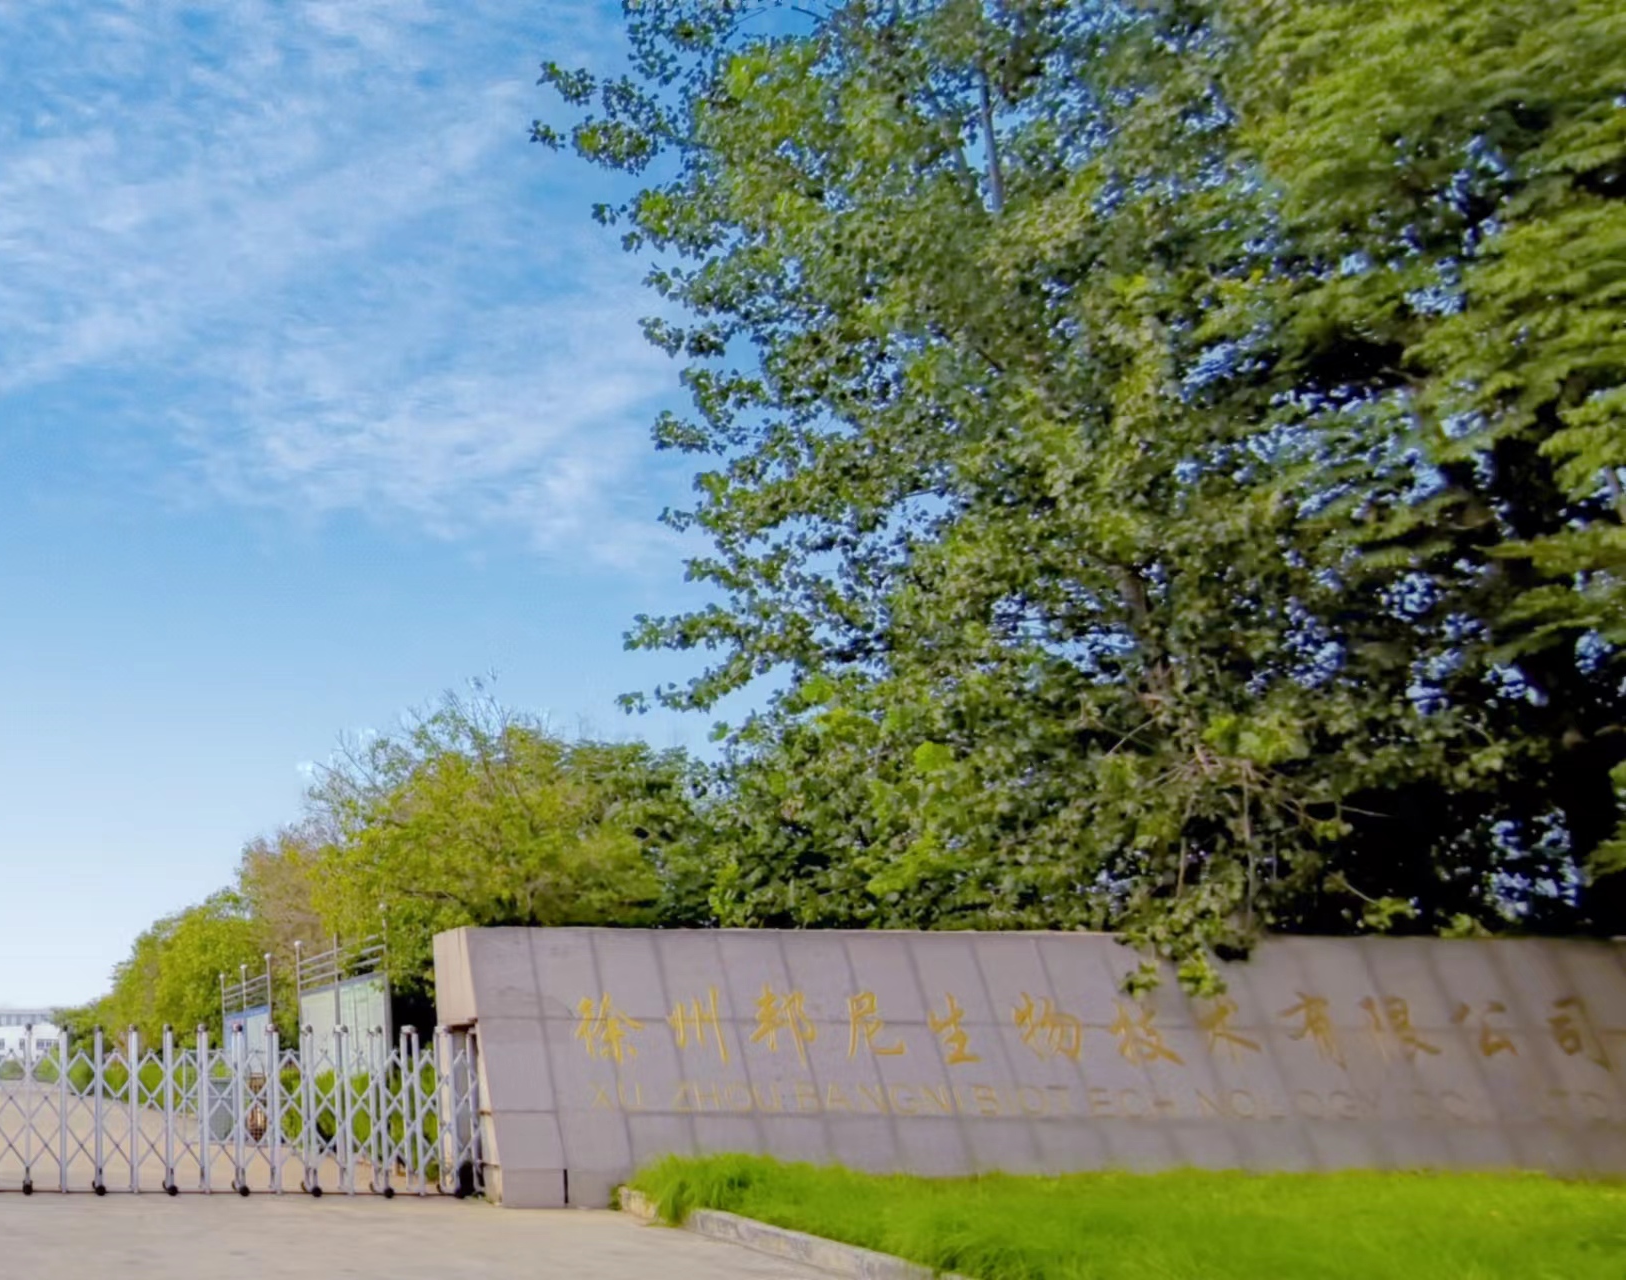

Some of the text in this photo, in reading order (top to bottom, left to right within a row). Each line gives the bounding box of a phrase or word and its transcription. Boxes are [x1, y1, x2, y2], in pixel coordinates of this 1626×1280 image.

[574, 984, 1614, 1074] 徐州邦尼生物技术有限公司
